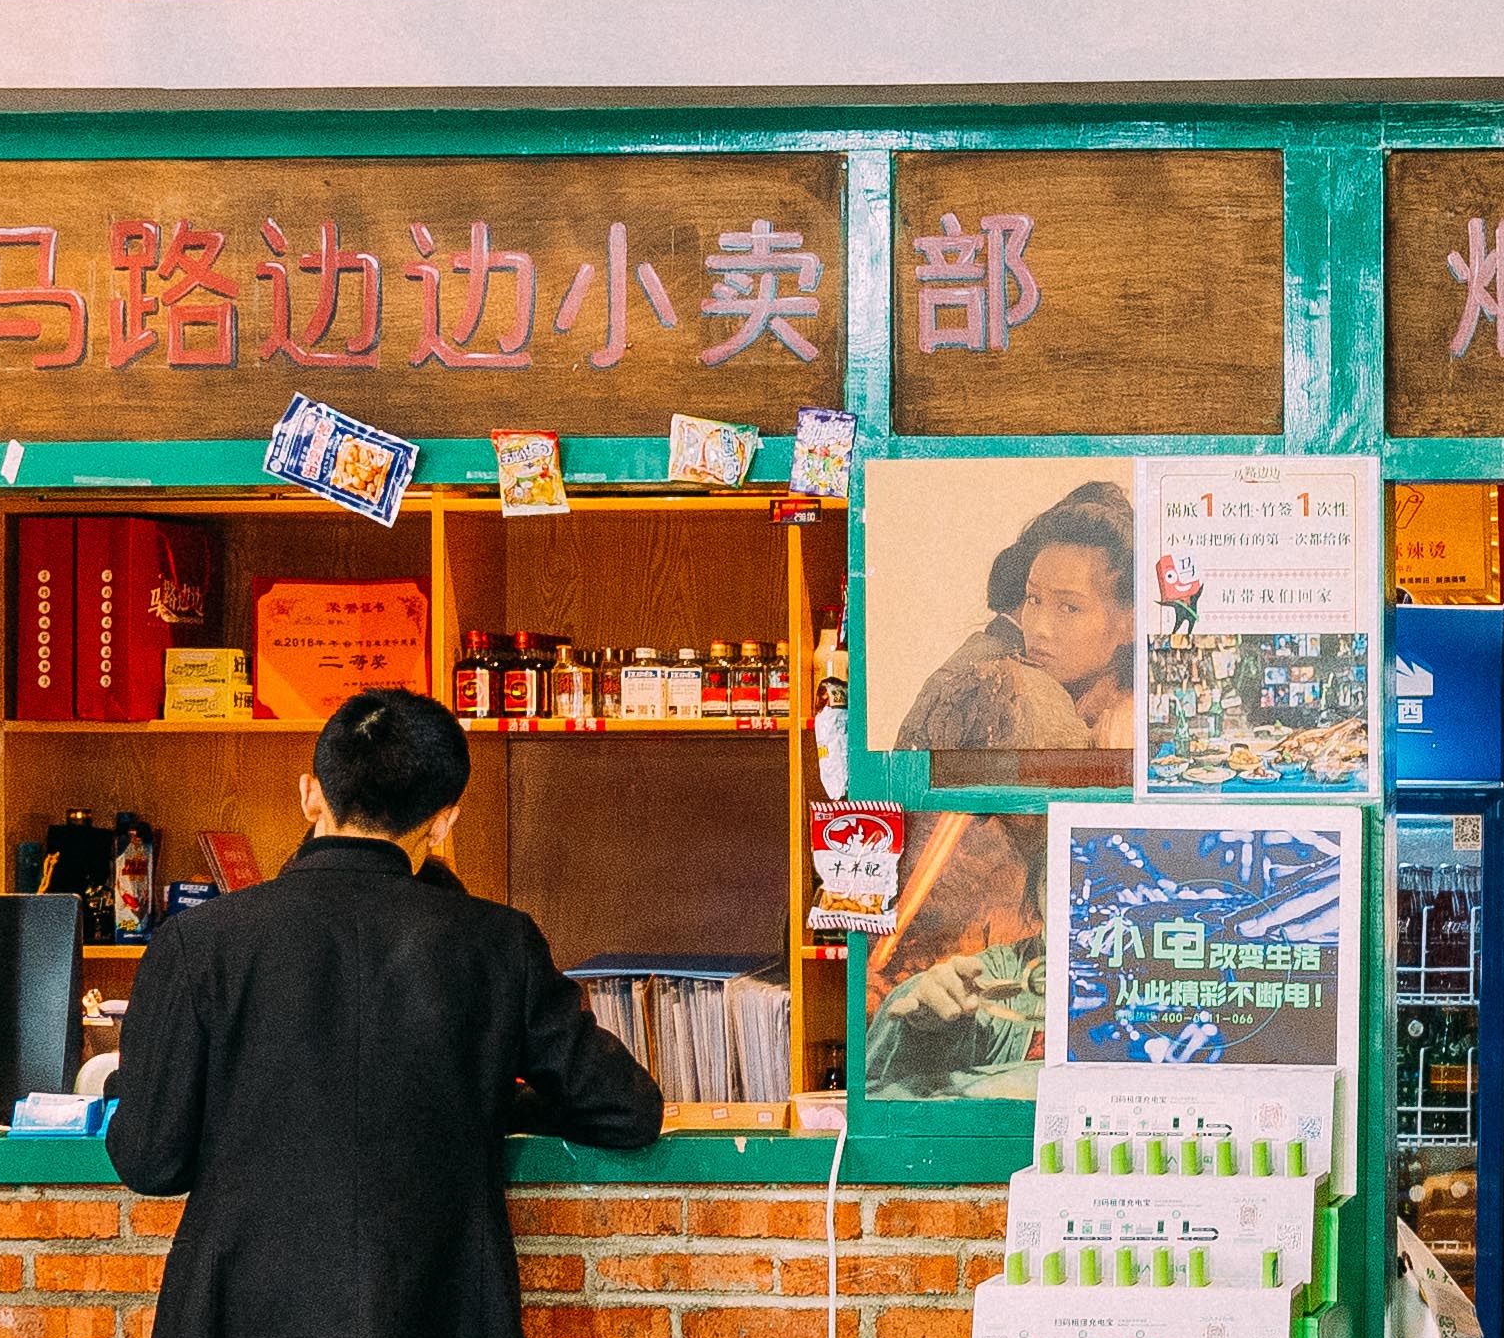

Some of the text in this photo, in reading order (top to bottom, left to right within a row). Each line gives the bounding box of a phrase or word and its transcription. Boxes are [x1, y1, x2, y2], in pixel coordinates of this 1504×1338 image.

[1222, 589, 1332, 604] 请带我们回家
[1088, 916, 1322, 971] 小电 改变生活
[1114, 979, 1323, 1009] 从此精彩不断电!
[1161, 1012, 1254, 1025] 400-011-066
